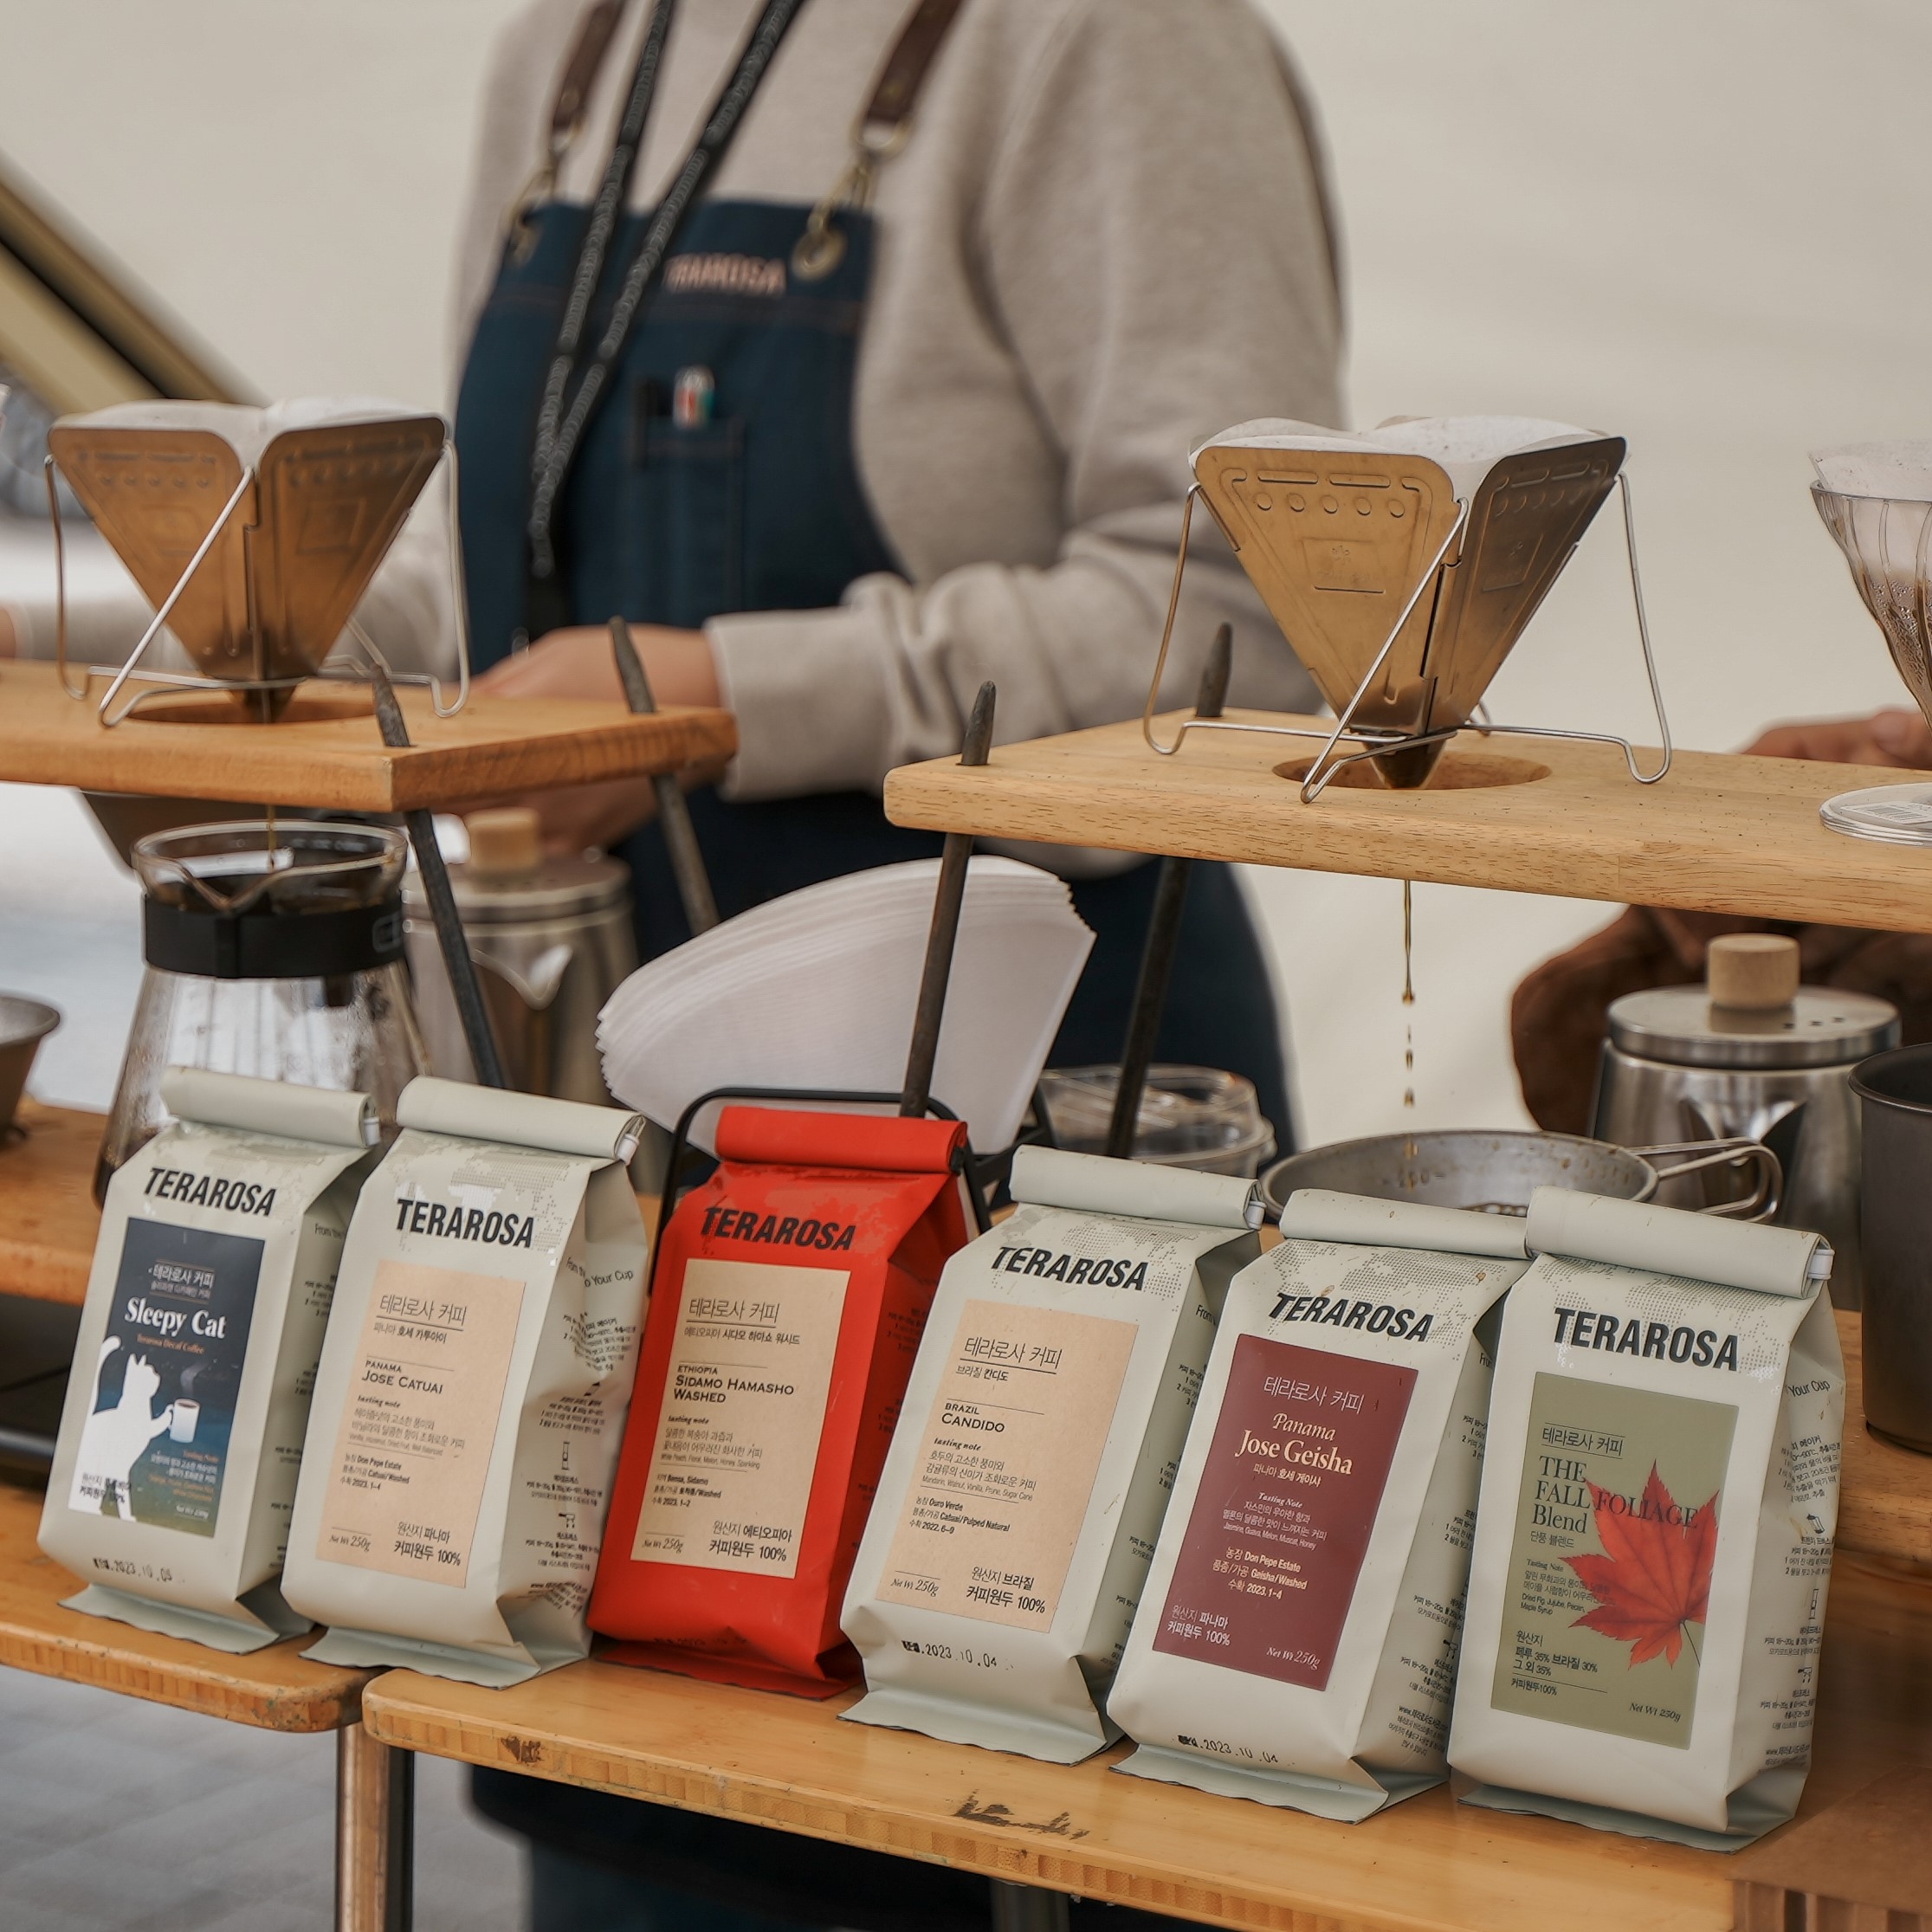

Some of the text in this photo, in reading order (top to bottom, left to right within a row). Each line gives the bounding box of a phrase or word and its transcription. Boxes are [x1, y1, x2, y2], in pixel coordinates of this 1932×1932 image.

[143, 1167, 276, 1217] TERAROSA
[396, 1198, 534, 1249] TERAROSA
[701, 1206, 856, 1251] TERAROSA
[152, 1263, 215, 1289] 테라로사 커피
[591, 1270, 634, 1286] Your Cup
[991, 1245, 1149, 1292] TERAROSA
[125, 1296, 227, 1339] Sleepy Cat
[379, 1295, 468, 1326] 테라로사 커피
[688, 1298, 780, 1323] 테라로사 커피
[1268, 1292, 1435, 1342] TERAROSA
[684, 1328, 720, 1340] 에티오피아
[775, 1332, 800, 1345] 워시드
[1554, 1307, 1739, 1372] TERAROSA
[964, 1336, 1063, 1369] 테라로사 커피
[365, 1360, 402, 1373] PANAMA
[677, 1365, 718, 1375] ETHIOPIA
[955, 1365, 1009, 1382] 브라질 칸디도
[673, 1387, 726, 1403] WASHED
[675, 1374, 794, 1396] SIDAMO HAMASHO
[1263, 1375, 1365, 1414] 테라로사 커피
[1788, 1380, 1831, 1397] Your Cup
[358, 1394, 383, 1407] tasting
[945, 1402, 980, 1415] BRAZIL
[668, 1415, 692, 1425] tasting
[941, 1412, 1005, 1433] CANDIDO
[1273, 1412, 1336, 1441] Panama
[450, 1438, 465, 1449] 커피
[710, 1431, 733, 1443] 과즙과
[934, 1438, 962, 1450] tasting
[1541, 1427, 1624, 1457] 테라로사 커피
[722, 1444, 746, 1457] 화사한
[746, 1446, 763, 1459] 커피
[929, 1451, 1005, 1471] 호두의 고소한 풍미와
[1234, 1429, 1353, 1475] Jose Geisha
[926, 1463, 1037, 1490] 감귤류의 산미가 조화로운 커피
[1253, 1463, 1277, 1477] 파나마
[1277, 1468, 1296, 1482] 호세
[1539, 1455, 1587, 1483] THE
[915, 1496, 929, 1506] 농장
[945, 1500, 964, 1512] Verde
[1002, 1489, 1018, 1500] Sugar
[1258, 1491, 1303, 1509] Tasting Note
[1535, 1479, 1700, 1528] FALL FOLIAGE
[912, 1507, 1011, 1532] 품종/가공 Natural
[1244, 1501, 1311, 1524] 자스민의 우아한 향과
[1531, 1504, 1587, 1534] Blend
[397, 1521, 451, 1544] 원산지 파나마
[713, 1520, 792, 1542] 원산지 에티오피아
[1244, 1513, 1266, 1527] 달콤한
[1282, 1522, 1311, 1537] 느껴지는
[1311, 1528, 1328, 1541] 커피
[350, 1535, 372, 1553] 250g
[662, 1538, 684, 1554] 250g
[1299, 1540, 1317, 1551] Honey
[1530, 1530, 1574, 1548] 단풍 블렌드
[394, 1540, 462, 1567] 커피원두 100%
[708, 1539, 787, 1562] 커피원두 100%
[1225, 1546, 1302, 1573] 농장 Don Pepe Estate
[1212, 1559, 1250, 1579] 품종/가공
[1550, 1563, 1564, 1572] Note
[890, 1577, 903, 1587] Net
[914, 1579, 940, 1598] 250g
[971, 1566, 1035, 1592] 원산지 브라질
[1228, 1579, 1245, 1592] 수확
[1540, 1573, 1567, 1586] 무화과의
[966, 1585, 1046, 1614] 커피원두 100%
[1520, 1602, 1554, 1615] Maple Syrup
[1522, 1593, 1536, 1603] Dried
[1171, 1604, 1230, 1630] 원산지 파나마
[1166, 1620, 1231, 1646] 커피원두 100%
[1516, 1630, 1543, 1647] 원산지
[1266, 1646, 1321, 1671] Net Wt 250g
[1513, 1659, 1552, 1677] 그 외 35%
[1515, 1647, 1533, 1660] 페루
[1552, 1654, 1580, 1671] 브라질
[1581, 1660, 1598, 1673] 30%
[1629, 1702, 1682, 1722] Net Wt 250g
